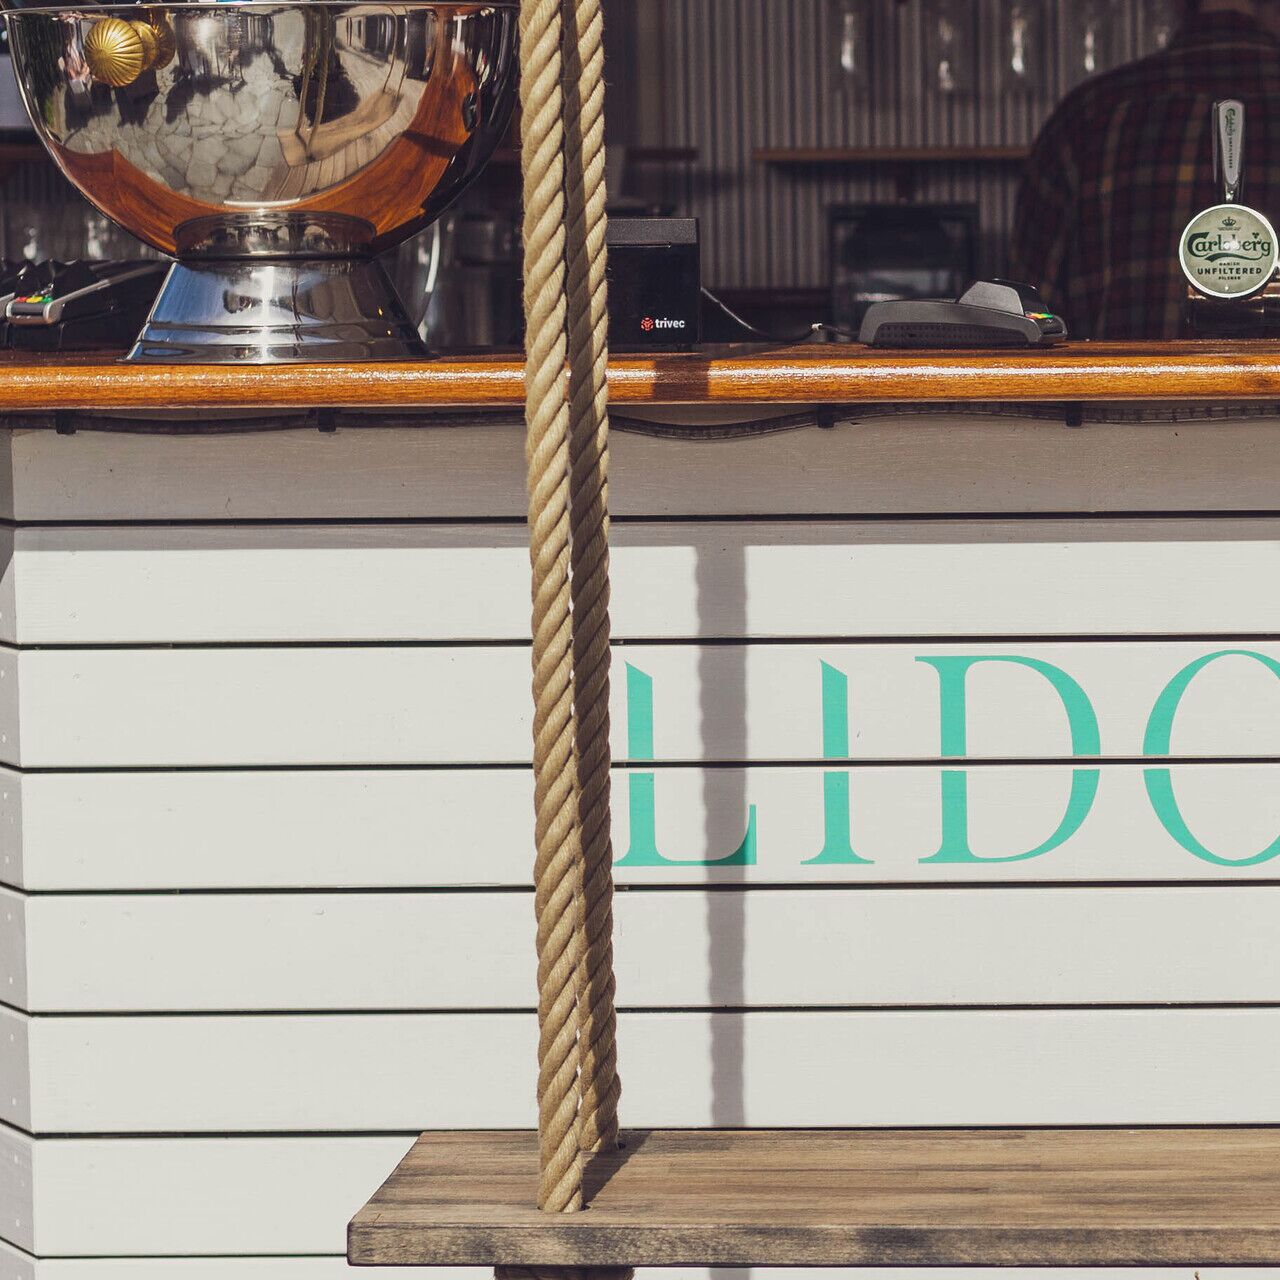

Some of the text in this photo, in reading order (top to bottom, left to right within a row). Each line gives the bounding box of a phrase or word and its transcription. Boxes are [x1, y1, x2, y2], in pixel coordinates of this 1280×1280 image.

[1187, 232, 1271, 262] Carlsberg
[1197, 267, 1262, 275] UNFILTERED
[655, 317, 685, 328] trivec
